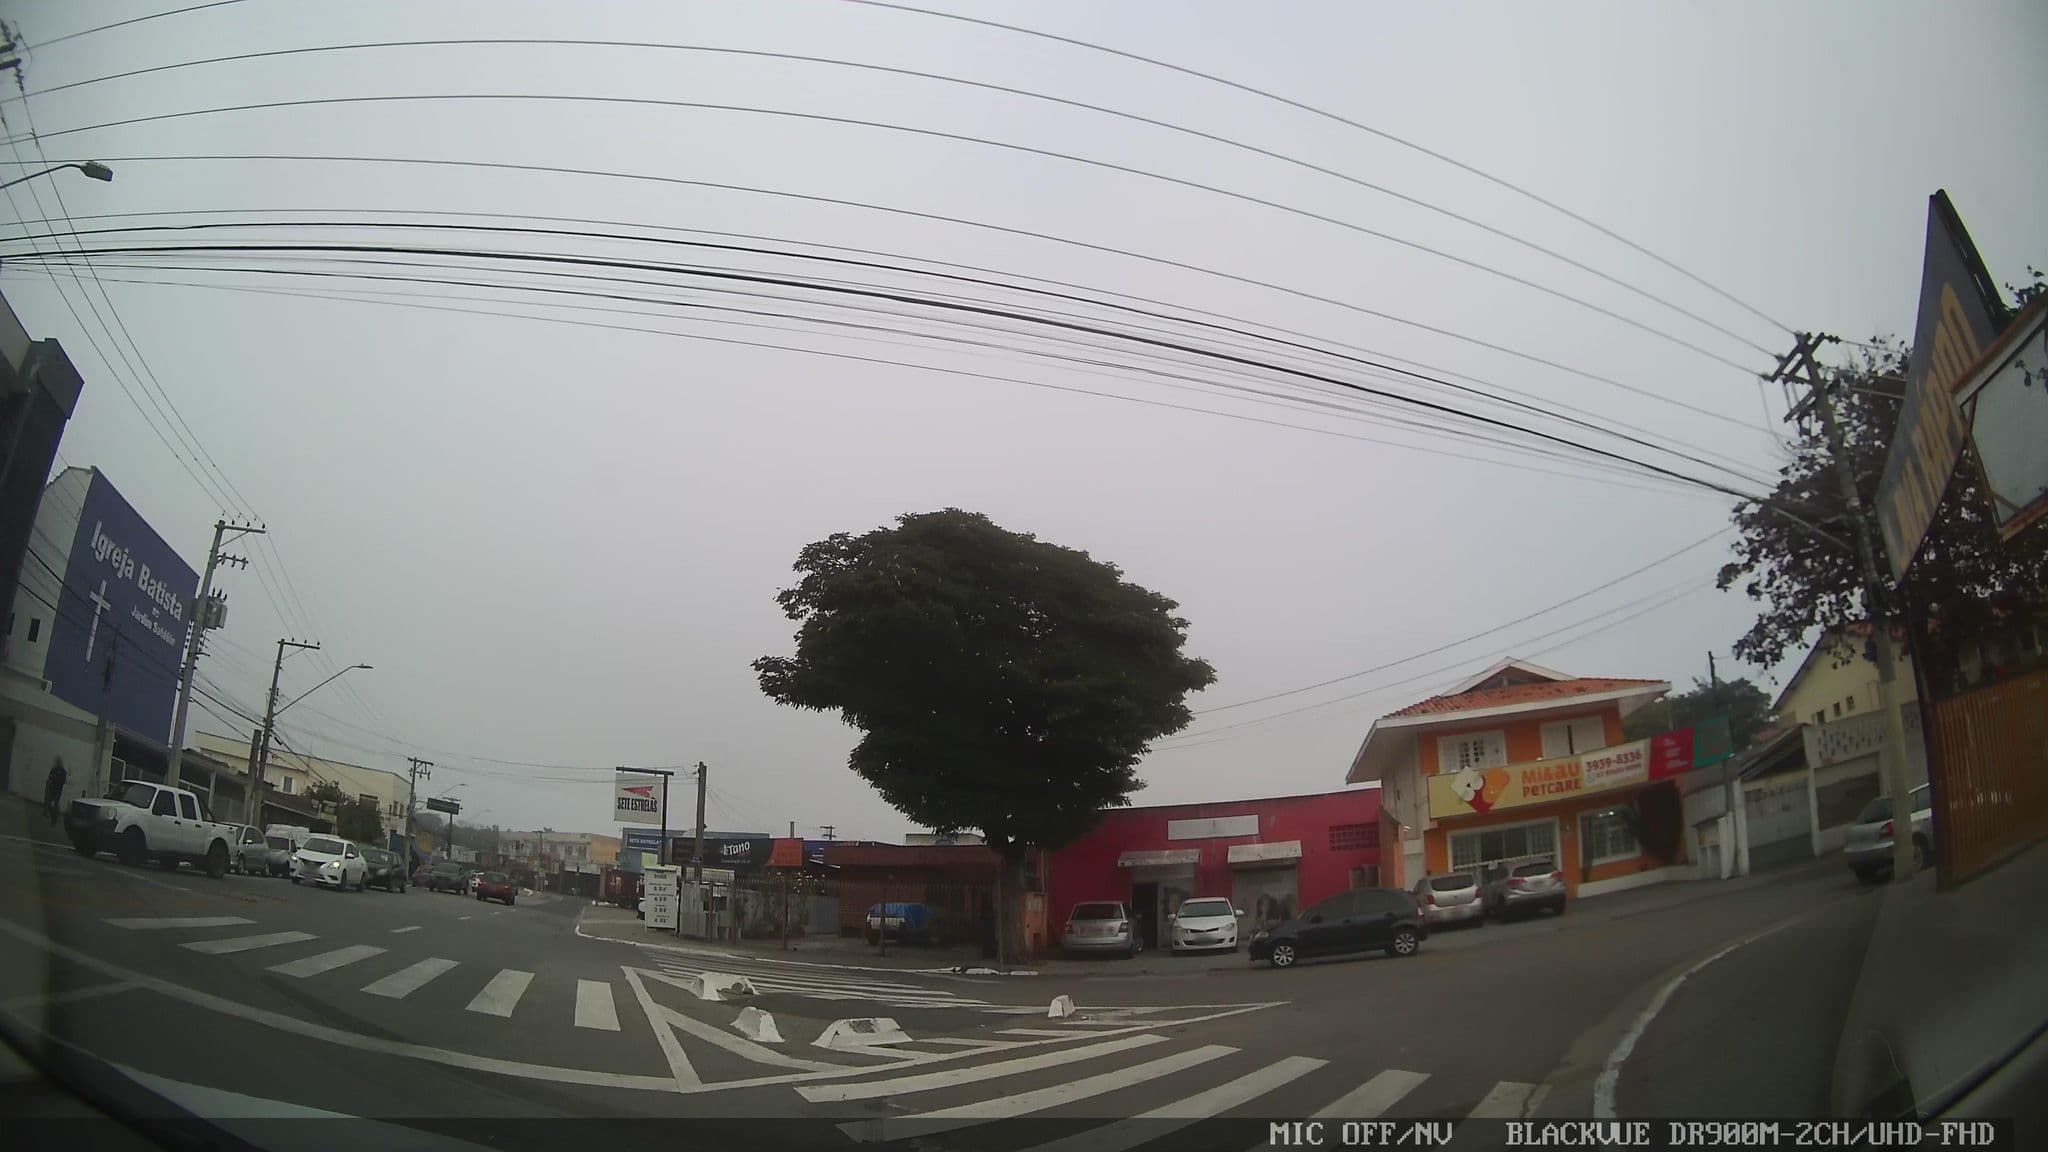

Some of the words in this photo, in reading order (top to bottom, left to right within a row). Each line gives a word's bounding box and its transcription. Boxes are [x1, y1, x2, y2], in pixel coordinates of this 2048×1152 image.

[91, 519, 135, 580] Igreja
[138, 563, 183, 622] Batista
[617, 797, 630, 810] SETE
[631, 797, 658, 813] ESTRELAS
